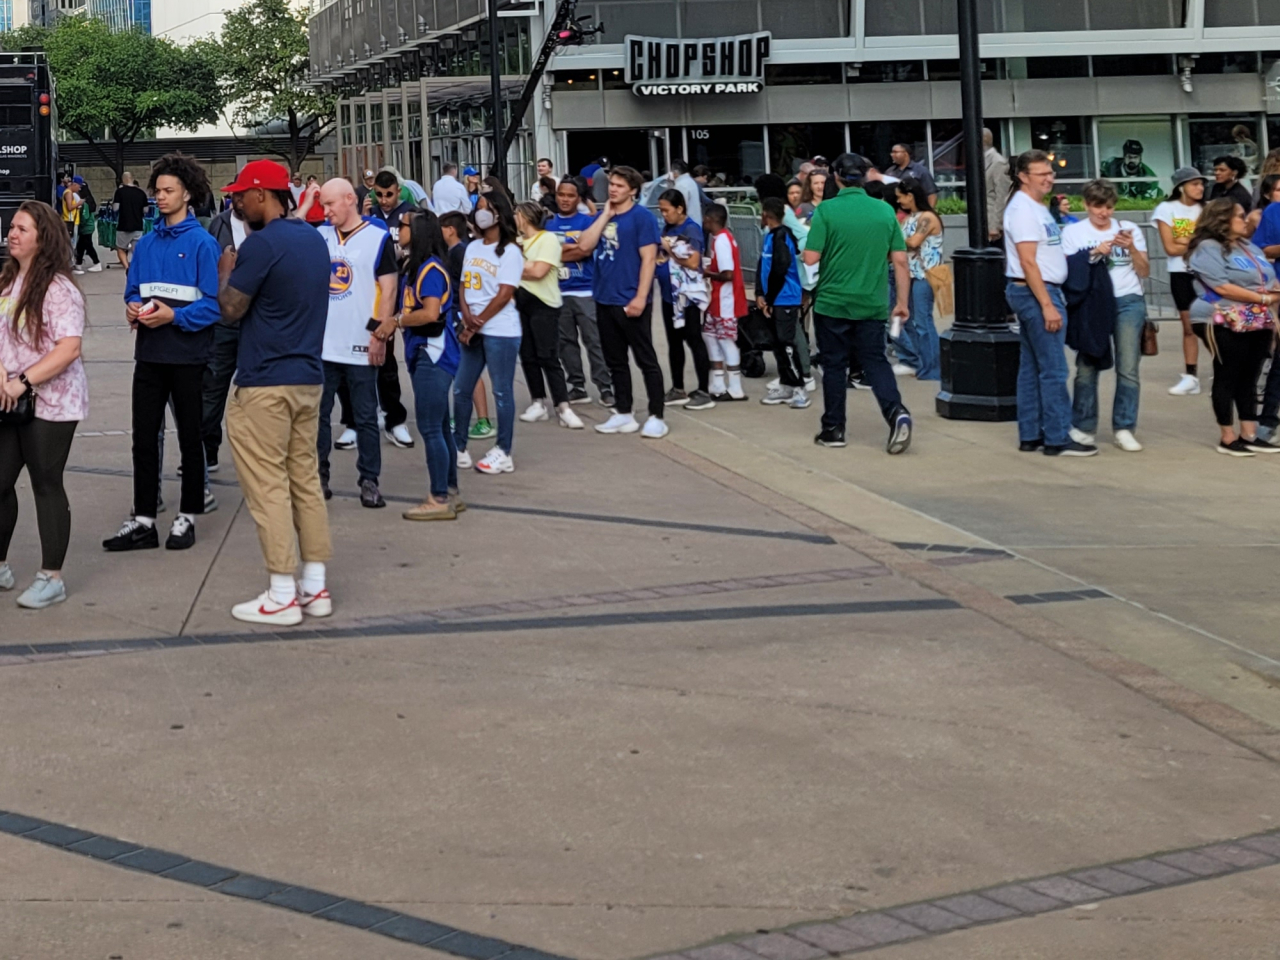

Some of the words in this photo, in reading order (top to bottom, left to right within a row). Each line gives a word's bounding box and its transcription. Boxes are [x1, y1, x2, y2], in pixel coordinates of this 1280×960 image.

[629, 35, 770, 82] CHOPSHOP
[640, 83, 712, 95] VICTORY
[714, 82, 759, 93] PARK
[690, 129, 710, 140] 105
[463, 270, 482, 291] 23
